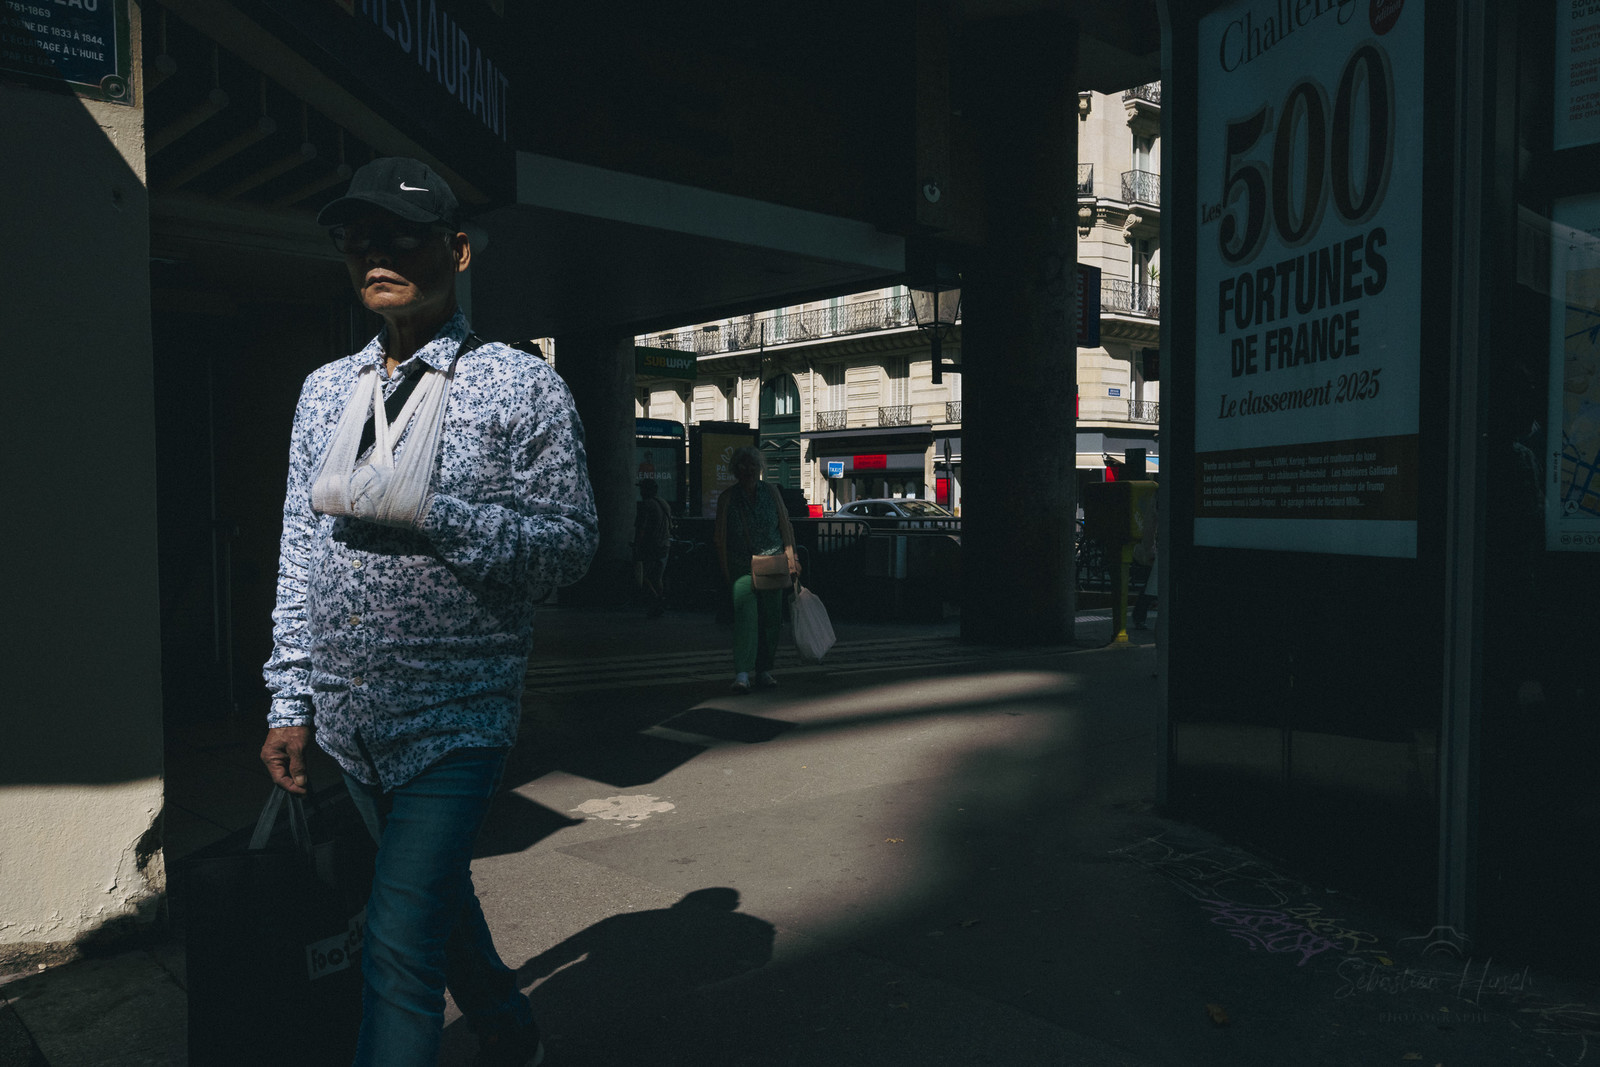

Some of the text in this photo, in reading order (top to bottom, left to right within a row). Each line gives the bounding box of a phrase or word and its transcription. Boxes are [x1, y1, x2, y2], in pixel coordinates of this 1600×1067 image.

[37, 24, 49, 34] DE
[51, 27, 72, 39] 1833
[82, 34, 105, 47] 1844.
[1219, 0, 1356, 72] Challe
[1572, 8, 1585, 19] DU
[72, 48, 105, 62] L'HUILE
[361, 0, 509, 143] STAURANT
[1218, 40, 1394, 267] 500
[1201, 203, 1222, 225] Les
[1218, 226, 1388, 335] FORTUNES
[644, 355, 693, 370] SUBWAY
[1231, 309, 1360, 378] DE FRANCE
[1218, 368, 1382, 419] Le classement 2025
